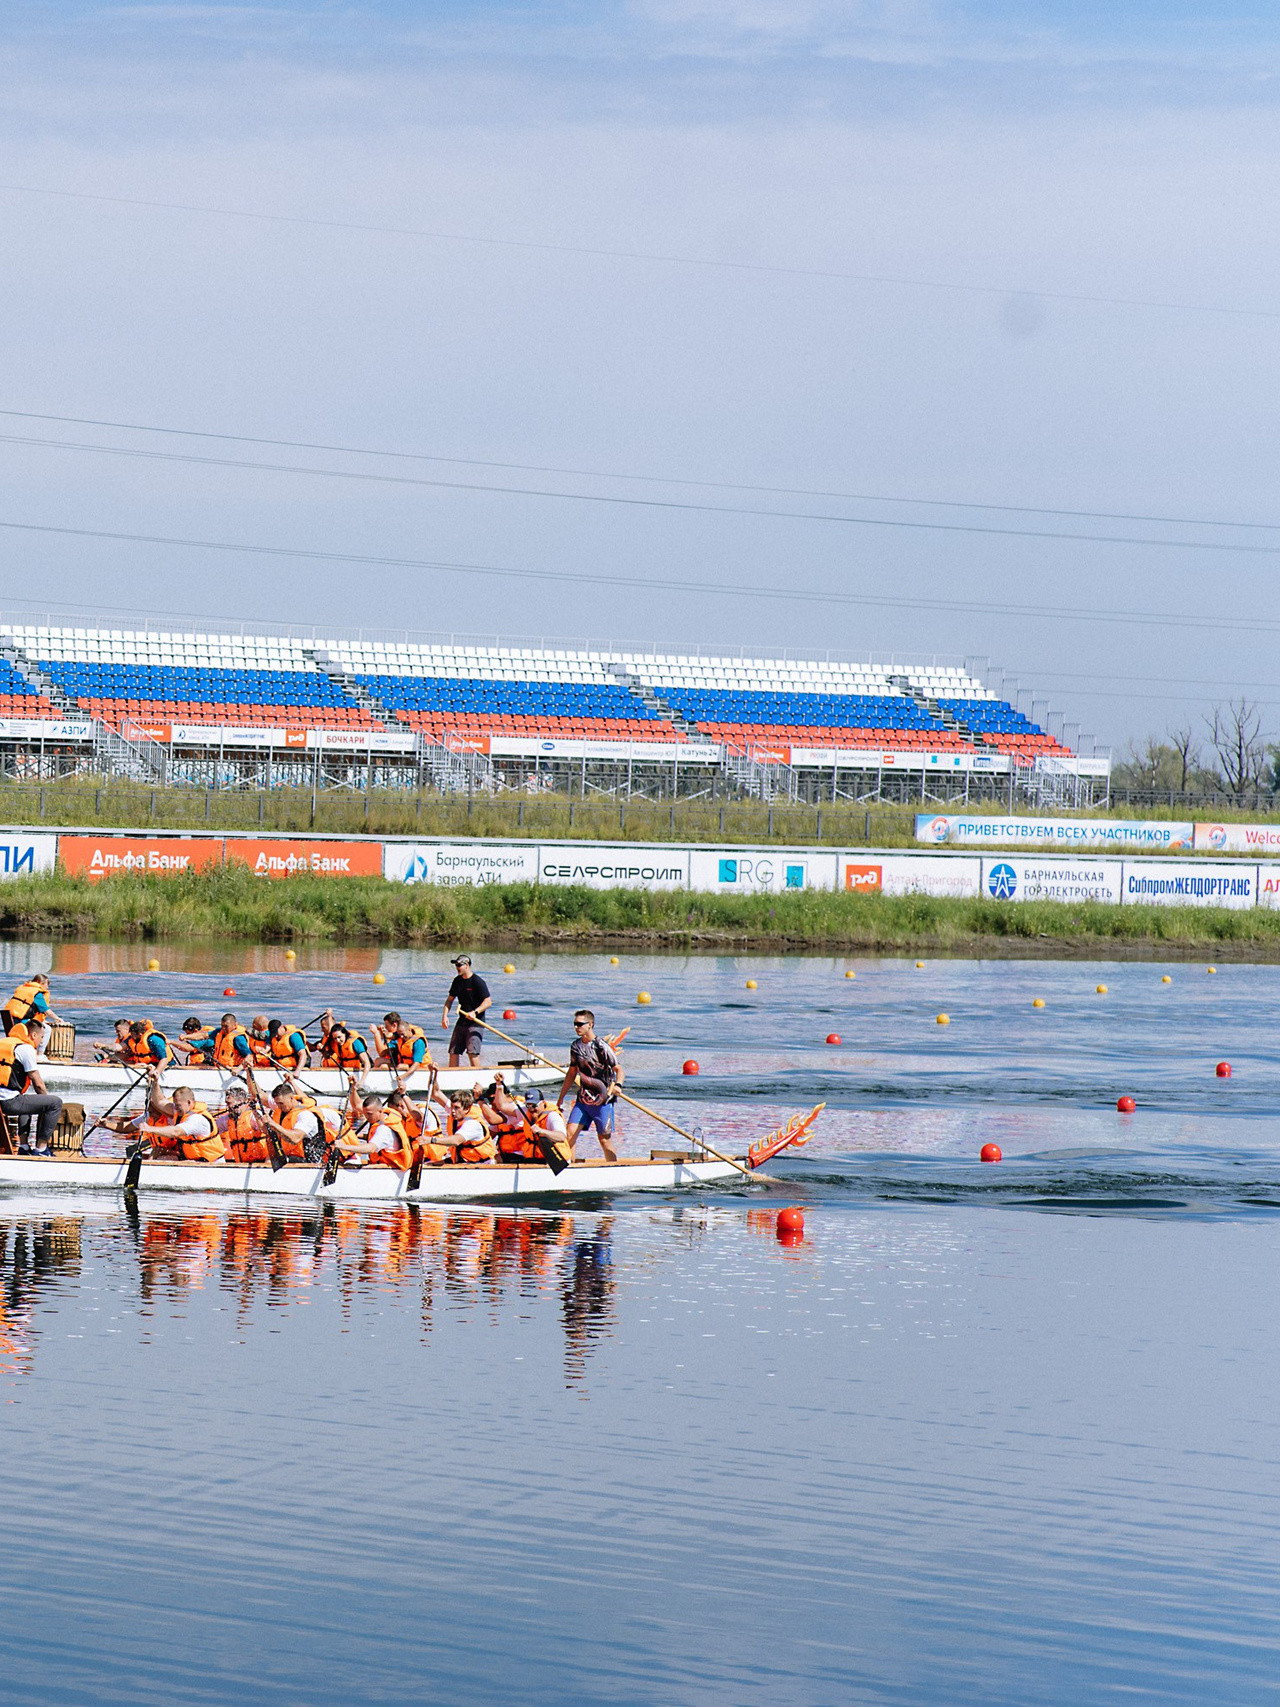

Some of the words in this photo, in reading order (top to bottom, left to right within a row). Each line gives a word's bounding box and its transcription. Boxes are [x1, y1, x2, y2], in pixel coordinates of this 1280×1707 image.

[61, 726, 87, 735] АЗПИ
[326, 735, 365, 744] БОЧКАРИ
[681, 748, 707, 758] Катунь
[958, 823, 1054, 838] ПРИВЕТСТВУЕМ
[1058, 826, 1088, 839] ВСЕХ
[1091, 827, 1171, 841] УЧАСТНИКОВ
[90, 849, 146, 871] Альфа
[148, 850, 191, 869] Банк
[255, 851, 308, 872] Альфа
[311, 852, 351, 871] Банк
[436, 852, 525, 871] Барнаульский
[724, 859, 774, 883] SRG
[1024, 869, 1104, 881] БАРНАУЛЬСКАЯ
[436, 874, 475, 886] завод
[477, 872, 502, 885] АТИ
[887, 873, 973, 887] Алтай-Пригород
[1128, 875, 1251, 897] СибпромЖЕЛДОРТРАНС
[1024, 885, 1113, 898] ГОРЭЛЕКТРОСЕТЬ
